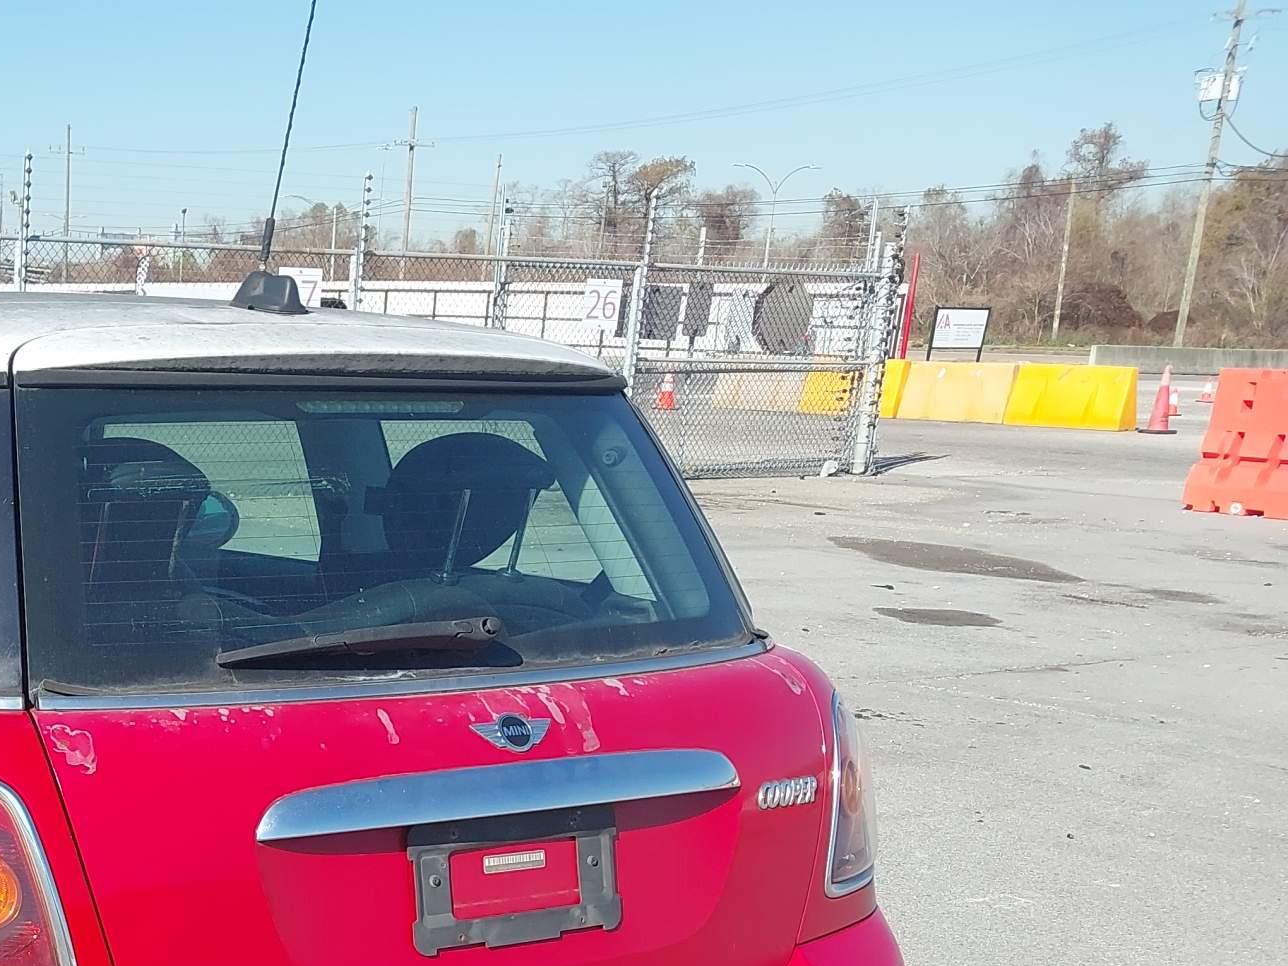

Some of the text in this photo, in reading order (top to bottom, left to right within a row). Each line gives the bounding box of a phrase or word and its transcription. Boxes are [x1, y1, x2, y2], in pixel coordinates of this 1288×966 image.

[301, 280, 318, 306] 7
[585, 289, 617, 320] 26
[503, 725, 530, 737] MINI
[757, 776, 817, 810] COOPER
